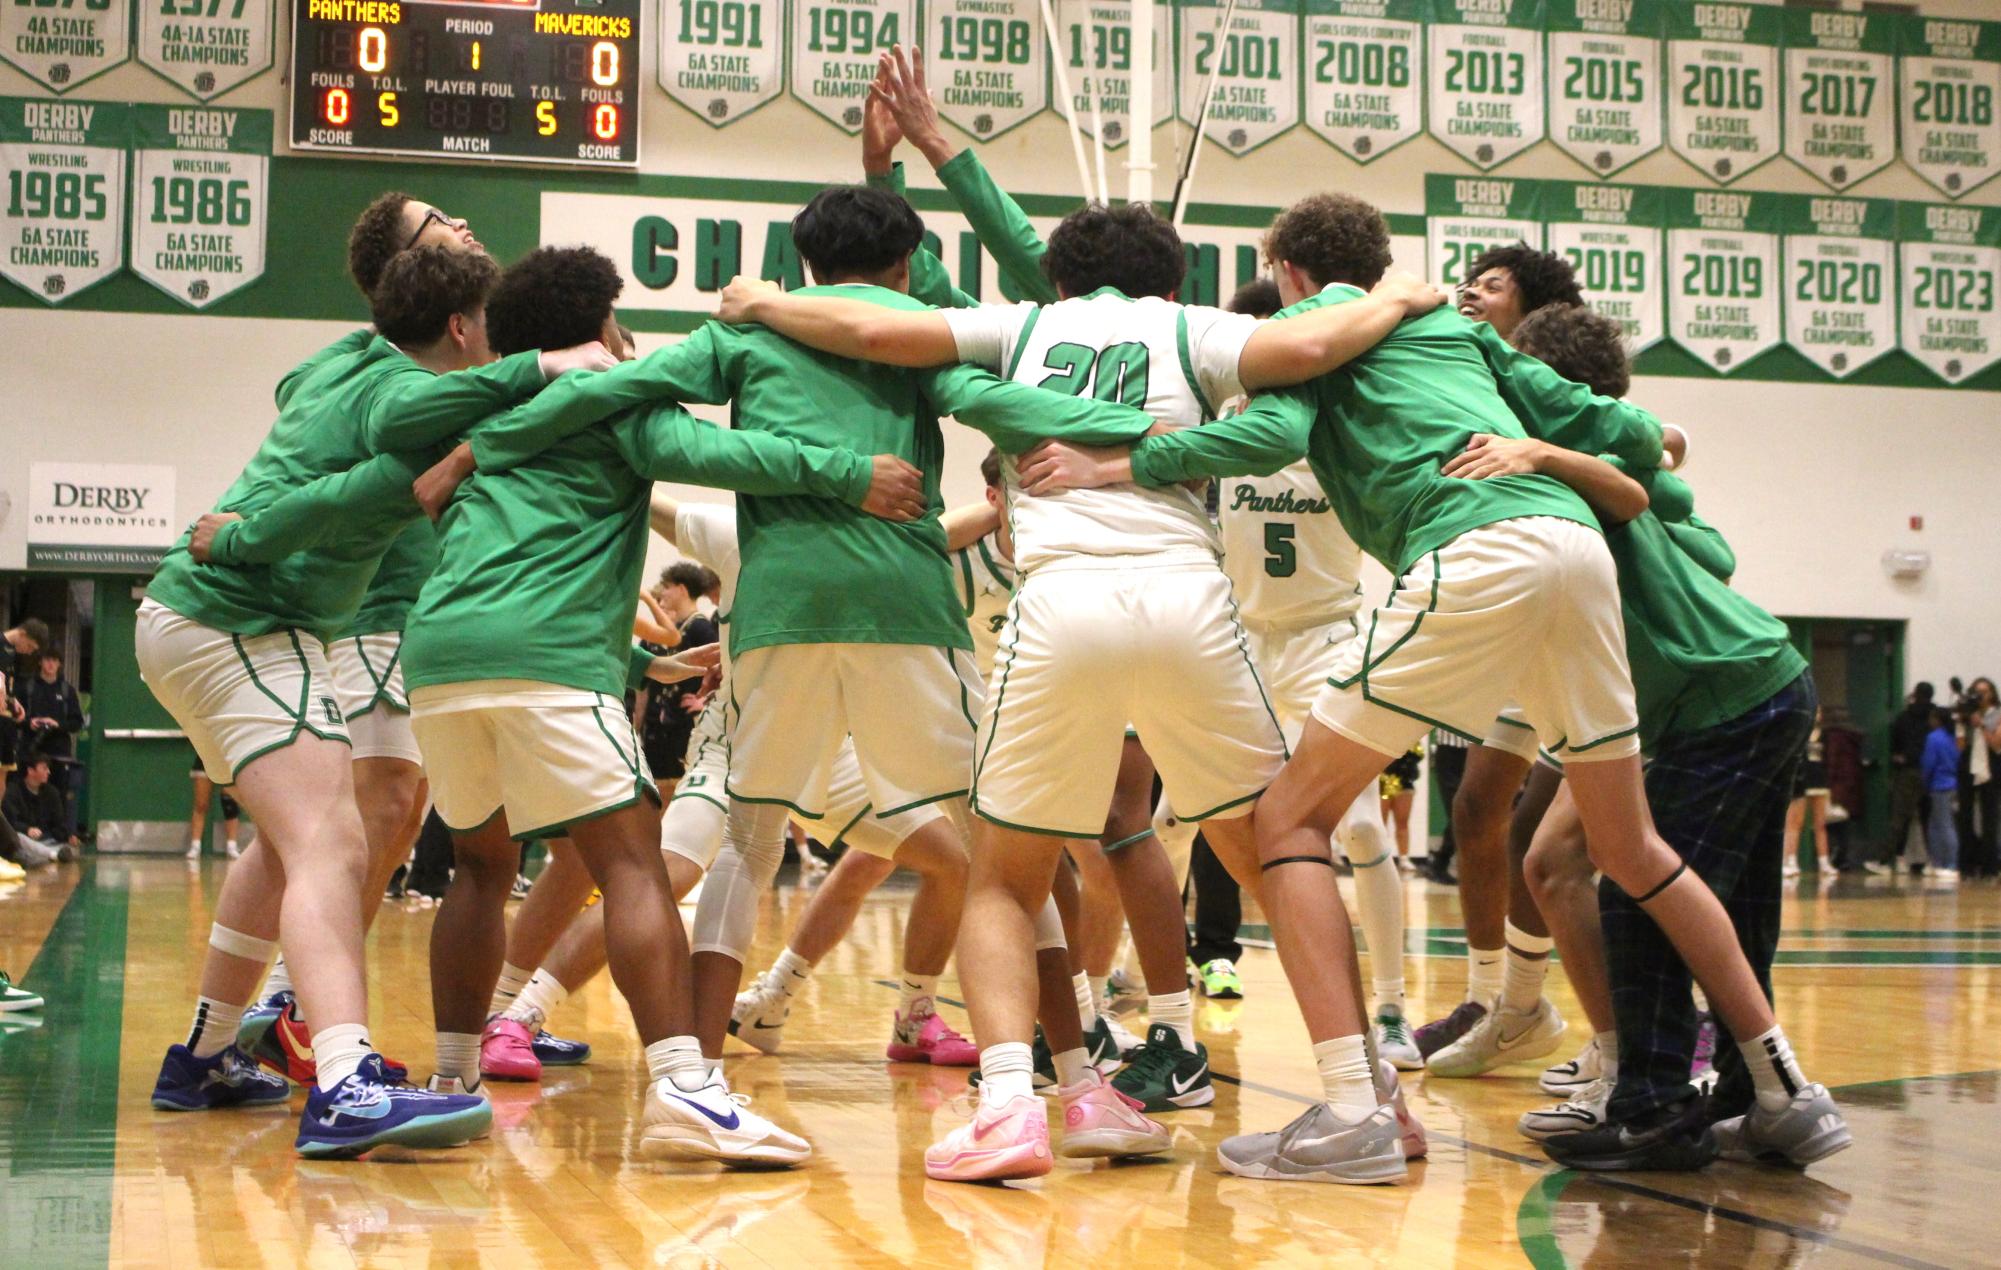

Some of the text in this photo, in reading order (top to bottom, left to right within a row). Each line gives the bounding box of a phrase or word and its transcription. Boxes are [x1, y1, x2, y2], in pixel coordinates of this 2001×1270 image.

[309, 0, 400, 24] PANTHERS
[1575, 0, 1632, 21] DERBY
[1694, 4, 1751, 30] DERBY
[28, 16, 95, 37] 4A STATE
[162, 24, 250, 46] 4A-1A STATE
[445, 18, 494, 35] PERIOD
[535, 12, 631, 38] MAVERICKS
[678, 0, 763, 49] 1991
[808, 7, 899, 55] 1994
[1811, 12, 1867, 38] DERBY
[1925, 20, 1981, 47] DERBY
[16, 35, 104, 57] CHAMPIONS
[359, 27, 386, 72] 0
[939, 15, 1030, 65] 1998
[162, 43, 248, 66] CHAMPIONS
[592, 42, 619, 86] 0
[688, 53, 750, 73] 6A STATE
[1195, 32, 1281, 80] 2001
[1315, 40, 1409, 88] 2008
[311, 72, 355, 89] FOULS
[823, 62, 876, 80] 6A STAT
[954, 69, 1014, 89] 6A STATE
[1445, 49, 1524, 95] 2013
[1564, 56, 1644, 103] 2015
[371, 76, 408, 92] T.O.L.
[425, 78, 515, 98] PLAYER FOUL
[530, 85, 566, 100] T.O.L.
[677, 71, 760, 93] CHAMPIONS
[1682, 64, 1763, 111] 2016
[581, 88, 623, 104] FOULS
[943, 87, 1024, 108] CHAMPIONS
[1230, 86, 1265, 104] STATE
[1334, 93, 1390, 112] 6A STATE
[1801, 72, 1877, 118] 2017
[1913, 81, 1992, 127] 2018
[24, 102, 95, 130] DERBY
[327, 89, 348, 124] 0
[379, 92, 399, 127] 5
[1207, 104, 1277, 122] HAMPIONS
[1457, 100, 1512, 119] 6A STATE
[168, 109, 237, 137] DERBY
[536, 101, 557, 136] 5
[595, 104, 617, 139] 0
[1324, 110, 1400, 131] CHAMPIONS
[1447, 118, 1523, 138] CHAMPIONS
[1576, 108, 1631, 127] 6A STATE
[1696, 116, 1749, 134] 6A STATE
[32, 128, 86, 144] PANTHERS
[176, 135, 229, 150] PANTHERS
[309, 128, 353, 145] SCORE
[1567, 125, 1640, 145] CHAMPIONS
[1687, 133, 1759, 153] CHAMPIONS
[1812, 123, 1865, 142] 6A STATE
[1927, 131, 1979, 150] 6A STATE
[442, 136, 490, 152] MATCH
[578, 143, 621, 160] SCORE
[1804, 139, 1874, 160] CHAMPIONS
[28, 152, 88, 168] WRESTLING
[173, 159, 231, 174] WRESTLING
[1919, 147, 1988, 168] CHAMPIONS
[7, 170, 107, 221] 1985
[150, 176, 251, 226] 1986
[1456, 179, 1514, 206] DERBY
[1575, 186, 1633, 212] DERBY
[1694, 192, 1751, 219] DERBY
[1811, 199, 1867, 225] DERBY
[1926, 206, 1982, 232] DERBY
[22, 226, 89, 248] 6A STATE
[167, 233, 232, 253] 6A STATE
[10, 246, 100, 268] CHAMPIONS
[155, 252, 243, 273] CHAMPIONS
[1683, 254, 1762, 298] 2019
[1797, 259, 1881, 305] 2020
[1914, 266, 1993, 312] 2023
[1597, 301, 1632, 318] STATE
[1695, 305, 1749, 323] 6A STATE
[1812, 311, 1864, 329] 6A STATE
[1687, 322, 1758, 341] CHAMPIONS
[1803, 328, 1874, 347] CHAMPIONS
[1926, 318, 1979, 336] 6A STATE
[1919, 335, 1988, 354] CHAMPIONS
[1037, 341, 1149, 411] 20
[53, 482, 150, 515] DERBY
[1230, 483, 1329, 514] Panthers
[34, 515, 167, 527] ORTHODONTICS
[1264, 523, 1296, 577] 5
